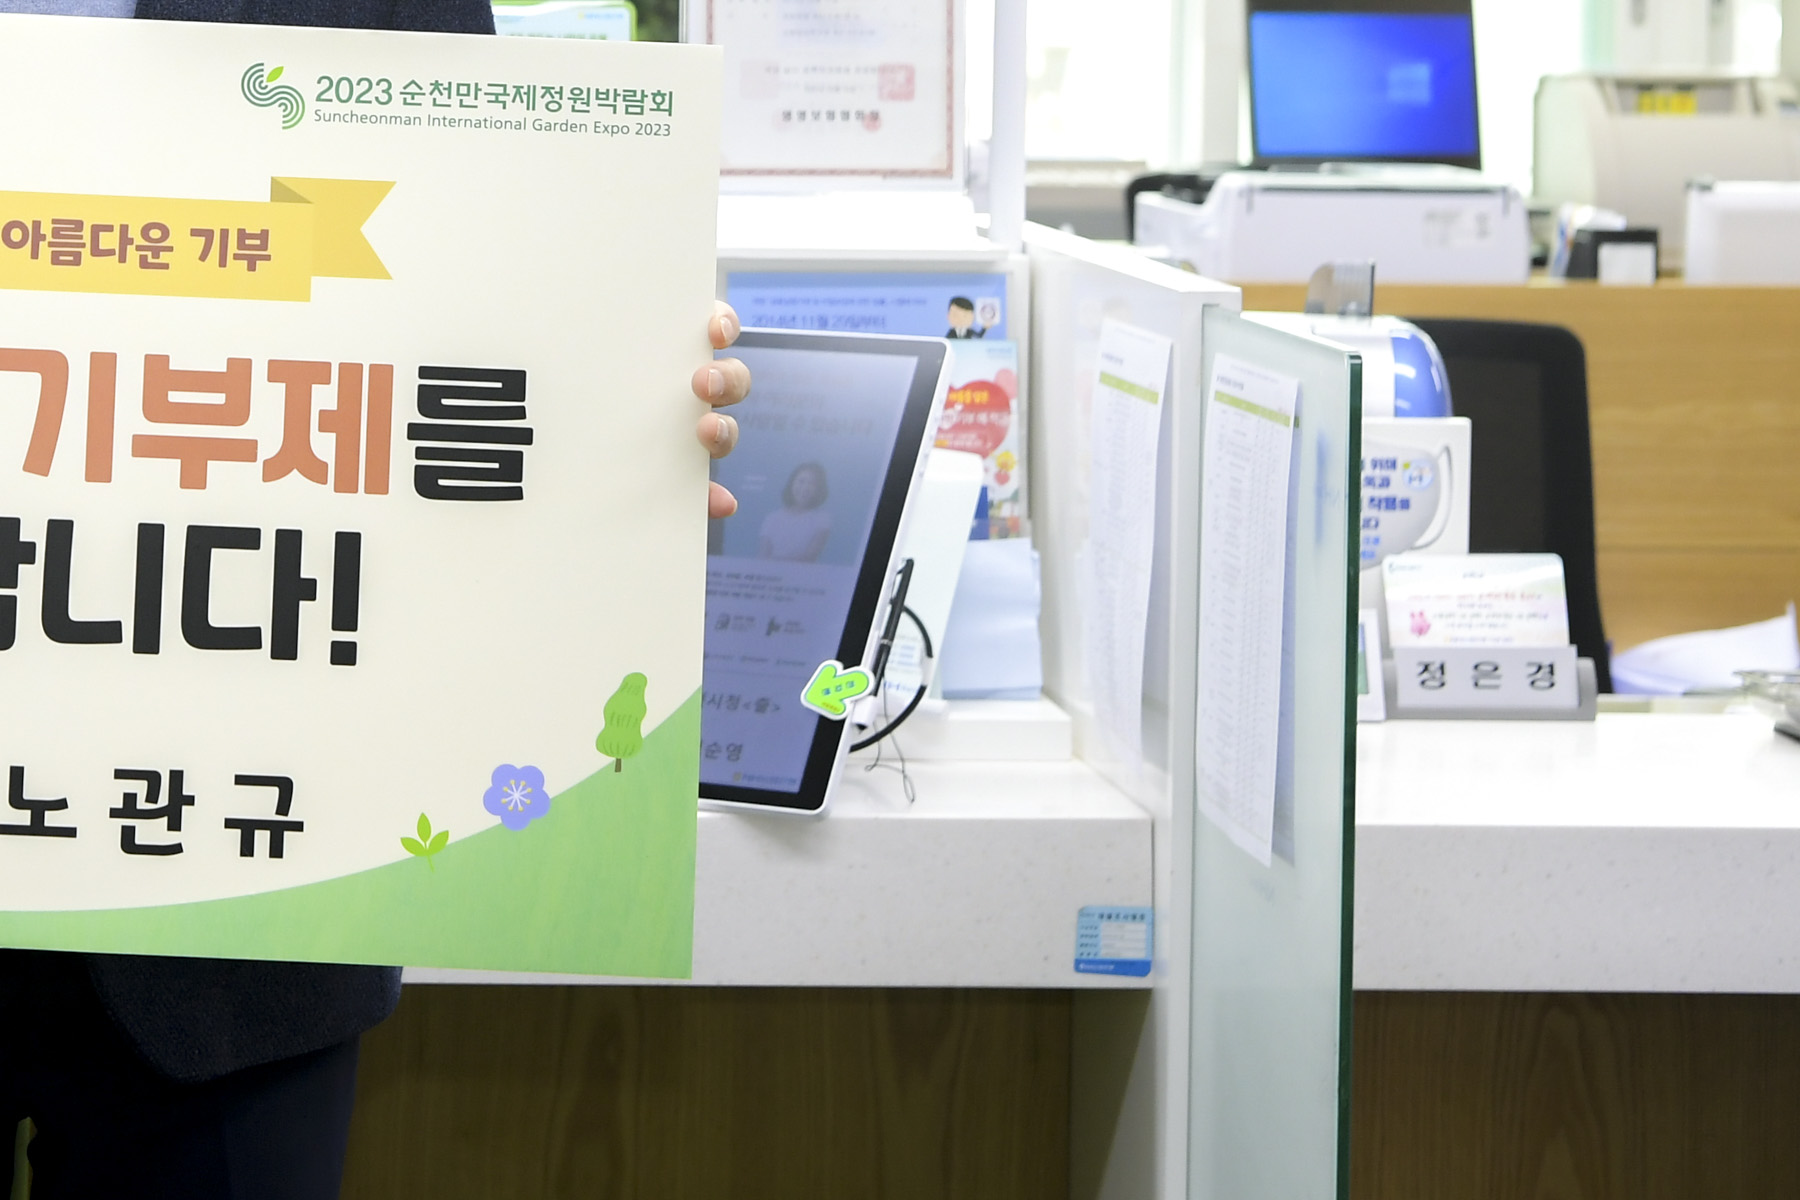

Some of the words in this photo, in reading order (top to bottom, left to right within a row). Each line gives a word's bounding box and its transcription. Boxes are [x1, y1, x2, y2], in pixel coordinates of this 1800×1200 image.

[315, 76, 393, 106] 2023
[399, 79, 674, 117] 순천만국제정원박람회
[313, 109, 422, 126] Suncheonman
[427, 114, 527, 131] International
[532, 118, 588, 133] Garden
[593, 121, 630, 137] Expo
[635, 122, 671, 137] 2023
[2, 219, 174, 270] 아름다운
[190, 228, 272, 272] 기부
